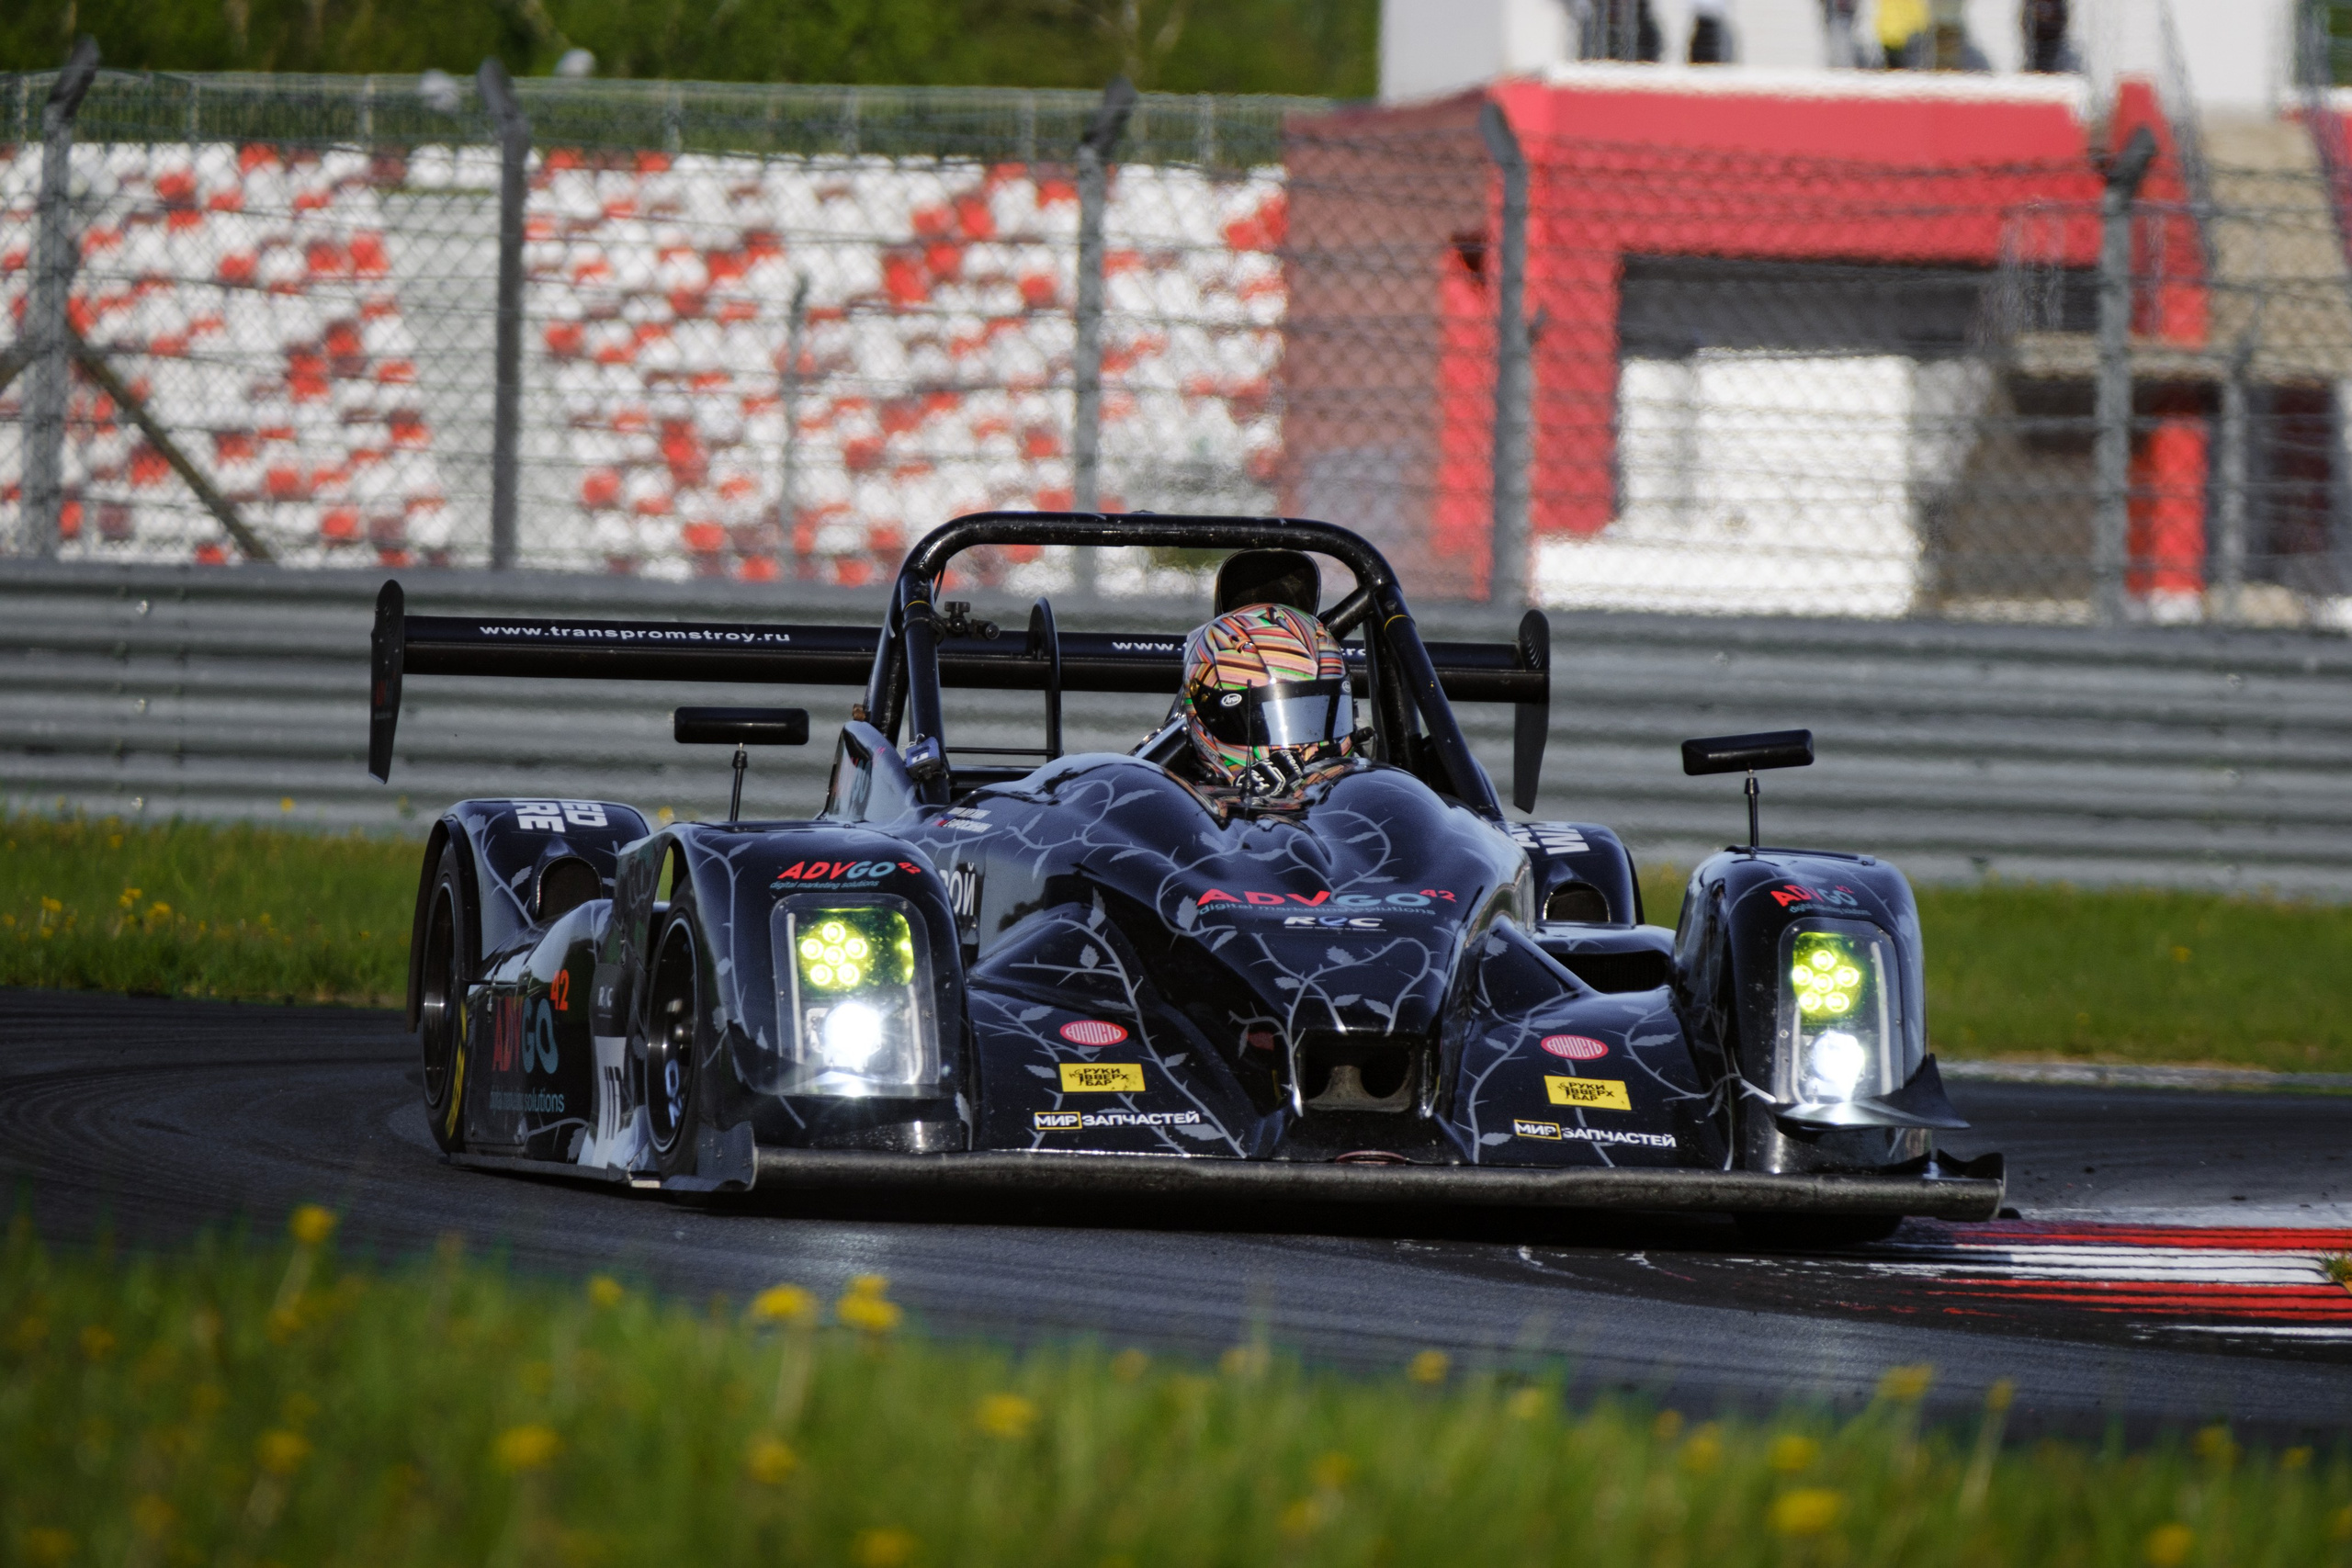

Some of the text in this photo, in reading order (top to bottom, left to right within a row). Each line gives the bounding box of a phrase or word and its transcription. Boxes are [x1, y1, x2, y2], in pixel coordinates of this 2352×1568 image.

[480, 626, 790, 643] www.transpromstroy.ru
[777, 861, 896, 880] ADVGO
[1196, 888, 1457, 907] ADVGO 42
[1198, 903, 1253, 915] digital
[1258, 905, 1351, 913] marketing
[549, 969, 570, 1010] 42
[1568, 1081, 1606, 1091] РУКИ
[1034, 1111, 1201, 1127] МИР ЗАПЧАСТЕЙ
[1514, 1122, 1678, 1148] МИР ЗАПЧАСТЕЙ
